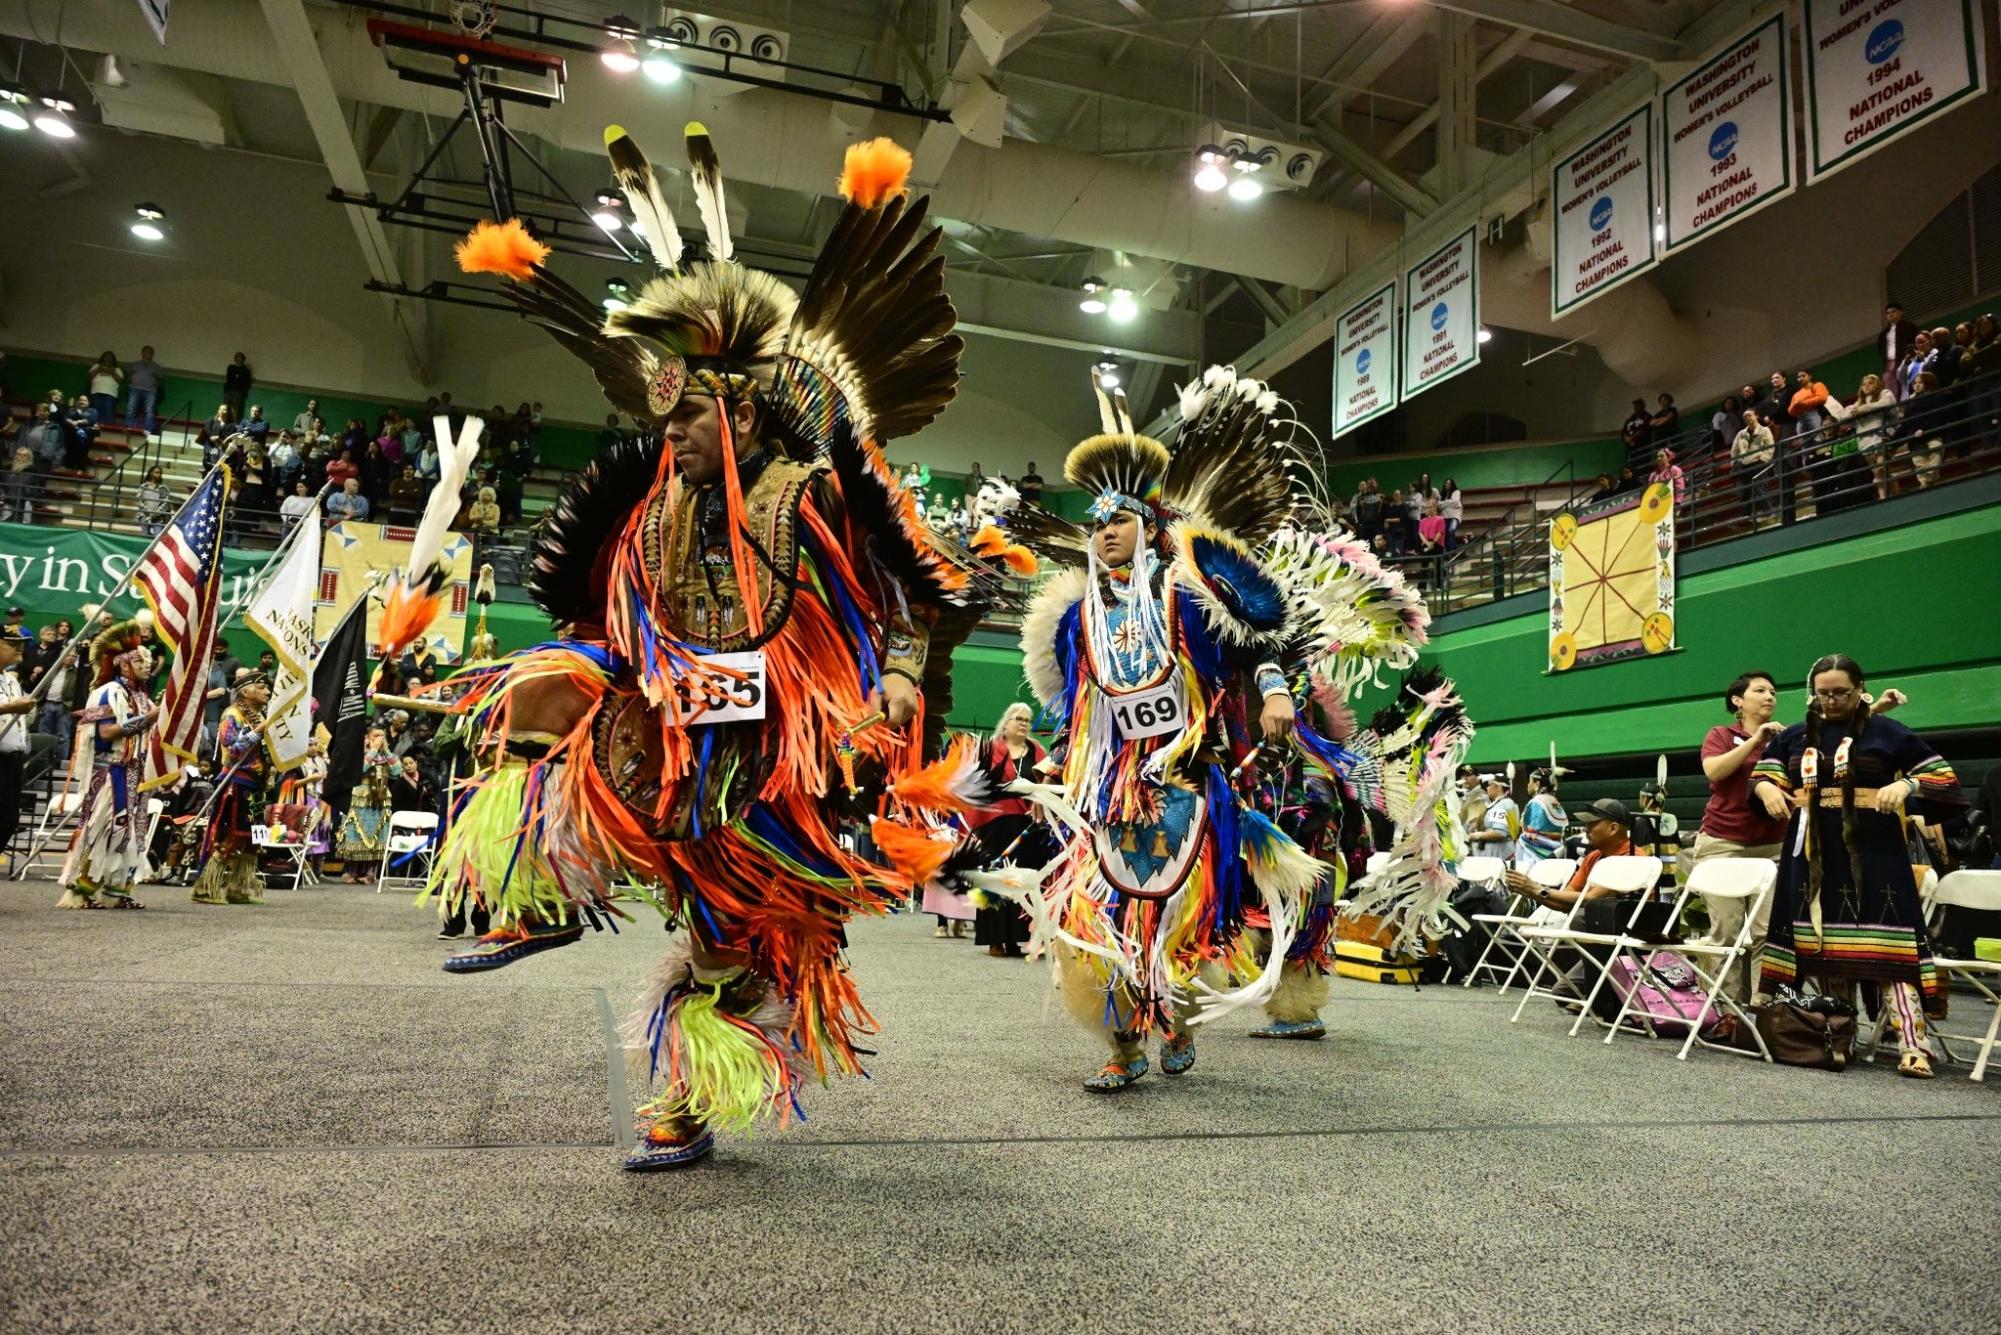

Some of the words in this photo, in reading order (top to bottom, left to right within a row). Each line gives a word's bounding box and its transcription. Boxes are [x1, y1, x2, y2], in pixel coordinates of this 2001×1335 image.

[1819, 10, 1872, 51] WOMEN'S
[1685, 38, 1760, 97] WASHINGTON
[1867, 57, 1901, 86] 1994
[1689, 60, 1757, 114] UNIVERSITY
[1849, 70, 1924, 121] NATIONAL
[1674, 110, 1714, 143] WOMEN'S
[1715, 73, 1774, 119] VOLLEYBALL
[1844, 87, 1934, 145] CHAMPIONS
[1571, 125, 1632, 174] WASHINGTON
[1574, 145, 1628, 188] UNIVERSITY
[1710, 153, 1737, 177] 1993
[1561, 186, 1595, 215] WOMEN'S
[1595, 157, 1642, 196] VOLLEYBALL
[1696, 166, 1753, 207] NATIONAL
[1692, 182, 1758, 228] CHAMPIONS
[1591, 228, 1612, 248] 1992
[1419, 243, 1463, 280] WASHINGTON
[1421, 259, 1460, 292] UNIVERSITY
[1575, 255, 1629, 294] CHAMPIONS
[1579, 240, 1624, 274] NATIONAL
[1412, 294, 1436, 312] WOMEN'S
[1436, 270, 1470, 299] VOLLEYBALL
[1347, 298, 1384, 327] WASHINGTON
[1348, 312, 1381, 339] UNIVERSITY
[1361, 322, 1389, 345] VOLLEYBALL
[1423, 339, 1455, 364] NATIONAL
[1432, 329, 1447, 345] 1991
[1419, 352, 1458, 381] CHAMPIONS
[1345, 397, 1379, 421] CHAMPIONS
[1349, 385, 1376, 404] NATIONAL
[38, 547, 91, 594] in
[1117, 696, 1178, 731] 169
